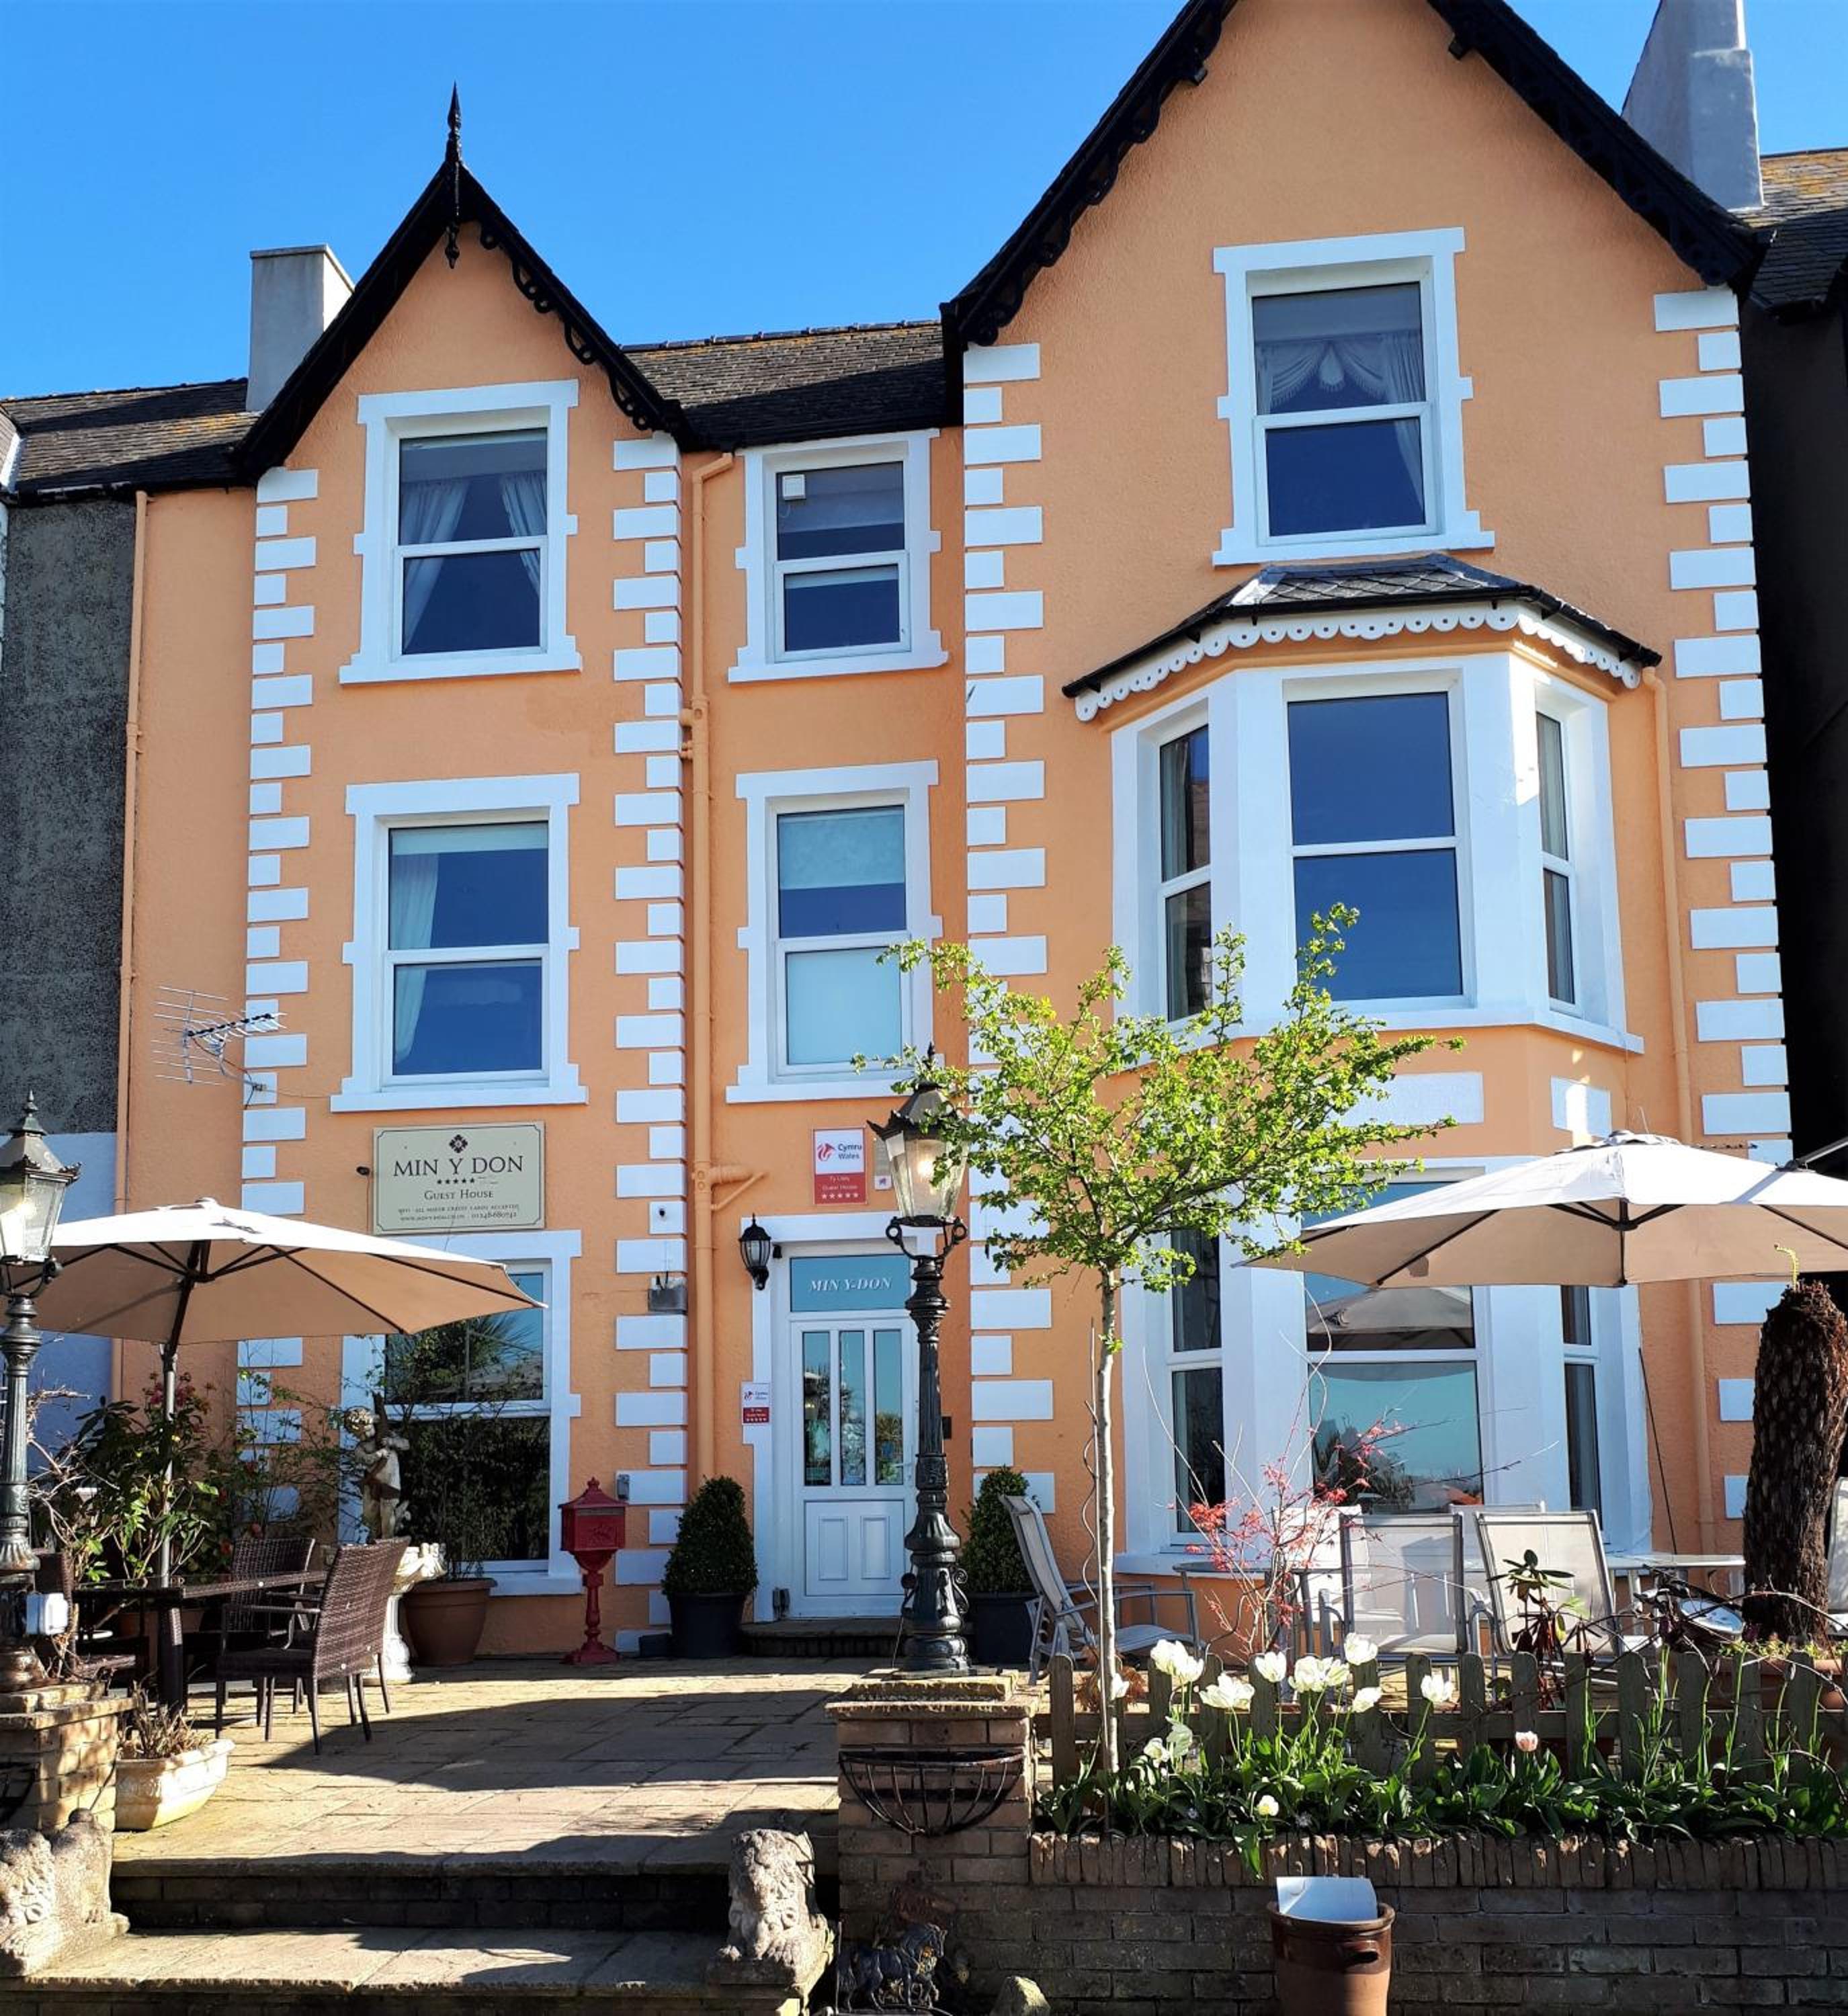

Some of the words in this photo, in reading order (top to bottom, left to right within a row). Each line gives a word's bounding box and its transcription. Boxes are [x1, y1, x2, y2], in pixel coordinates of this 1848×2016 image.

[837, 1143, 862, 1152] Cymru
[838, 1152, 860, 1160] Wales
[393, 1159, 438, 1177] MIN
[449, 1158, 464, 1175] Y
[471, 1155, 523, 1175] DON
[810, 1279, 839, 1291] MIN
